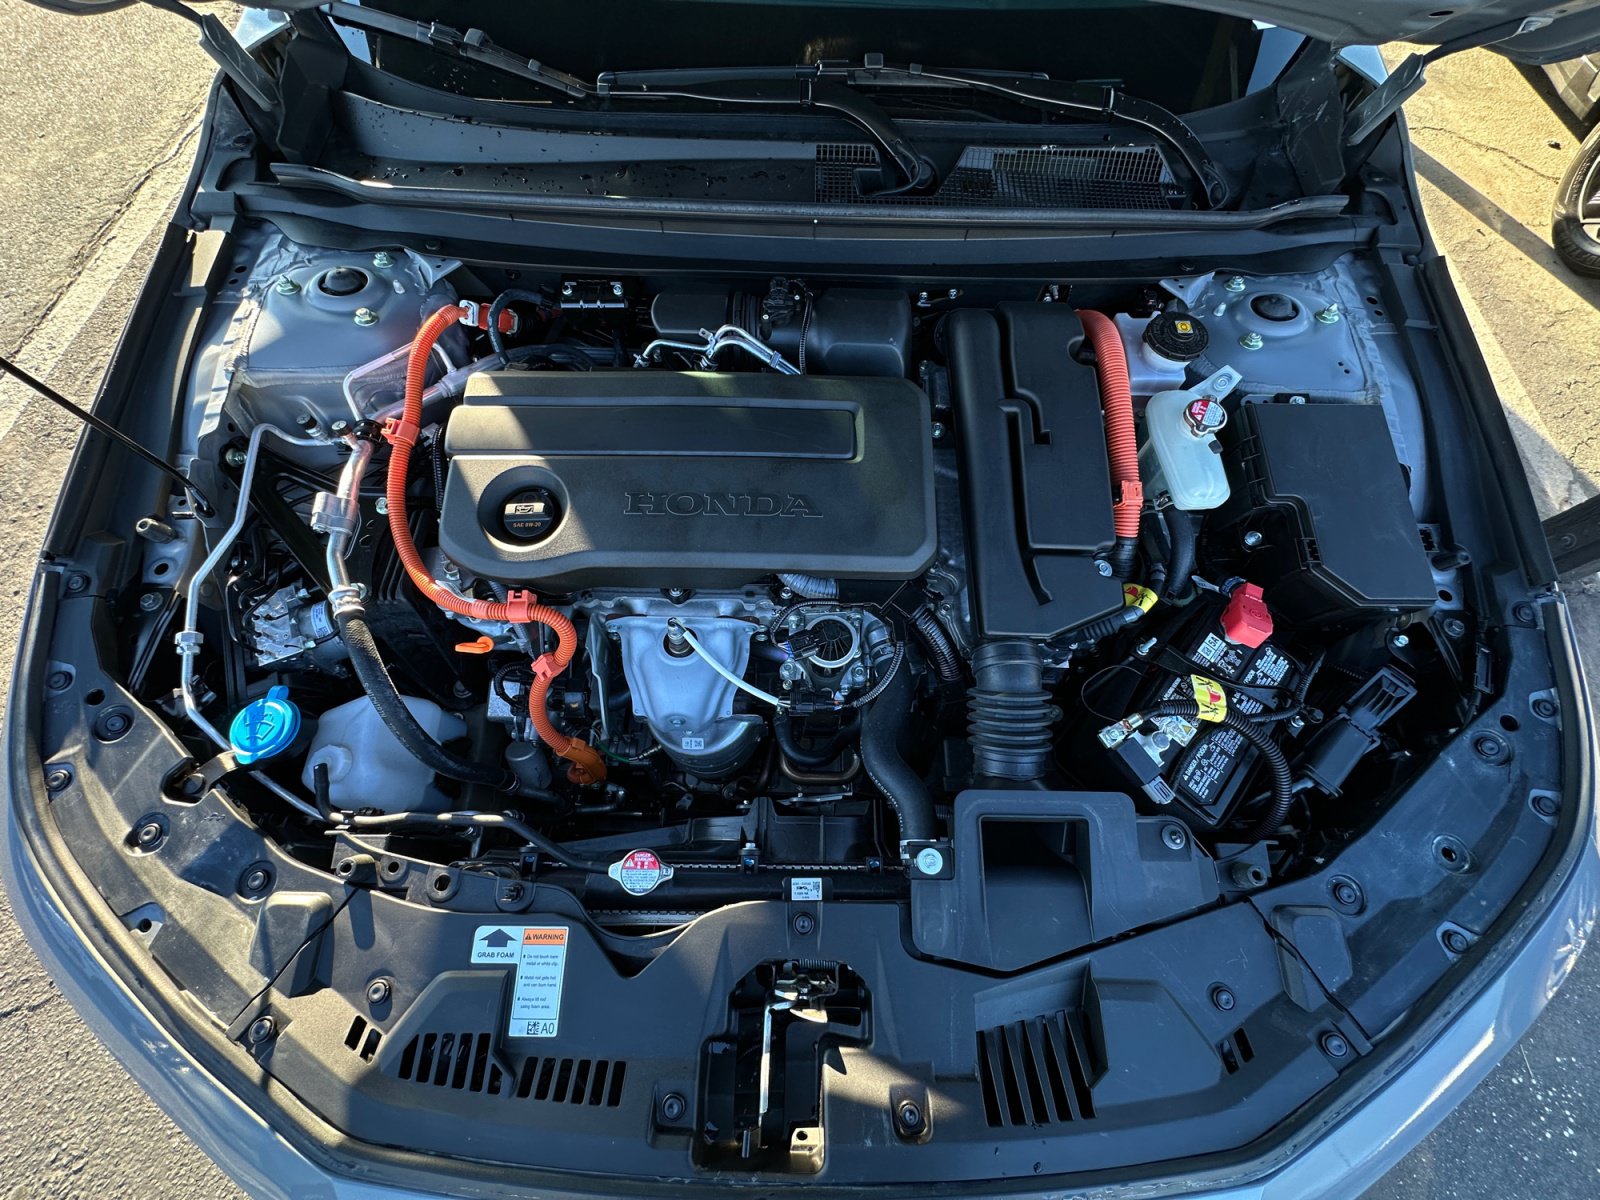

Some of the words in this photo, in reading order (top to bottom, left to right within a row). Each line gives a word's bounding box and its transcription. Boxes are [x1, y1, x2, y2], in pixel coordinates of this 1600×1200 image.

[622, 491, 824, 518] HONDA
[1207, 636, 1219, 647] 5A
[540, 1022, 555, 1034] A0
